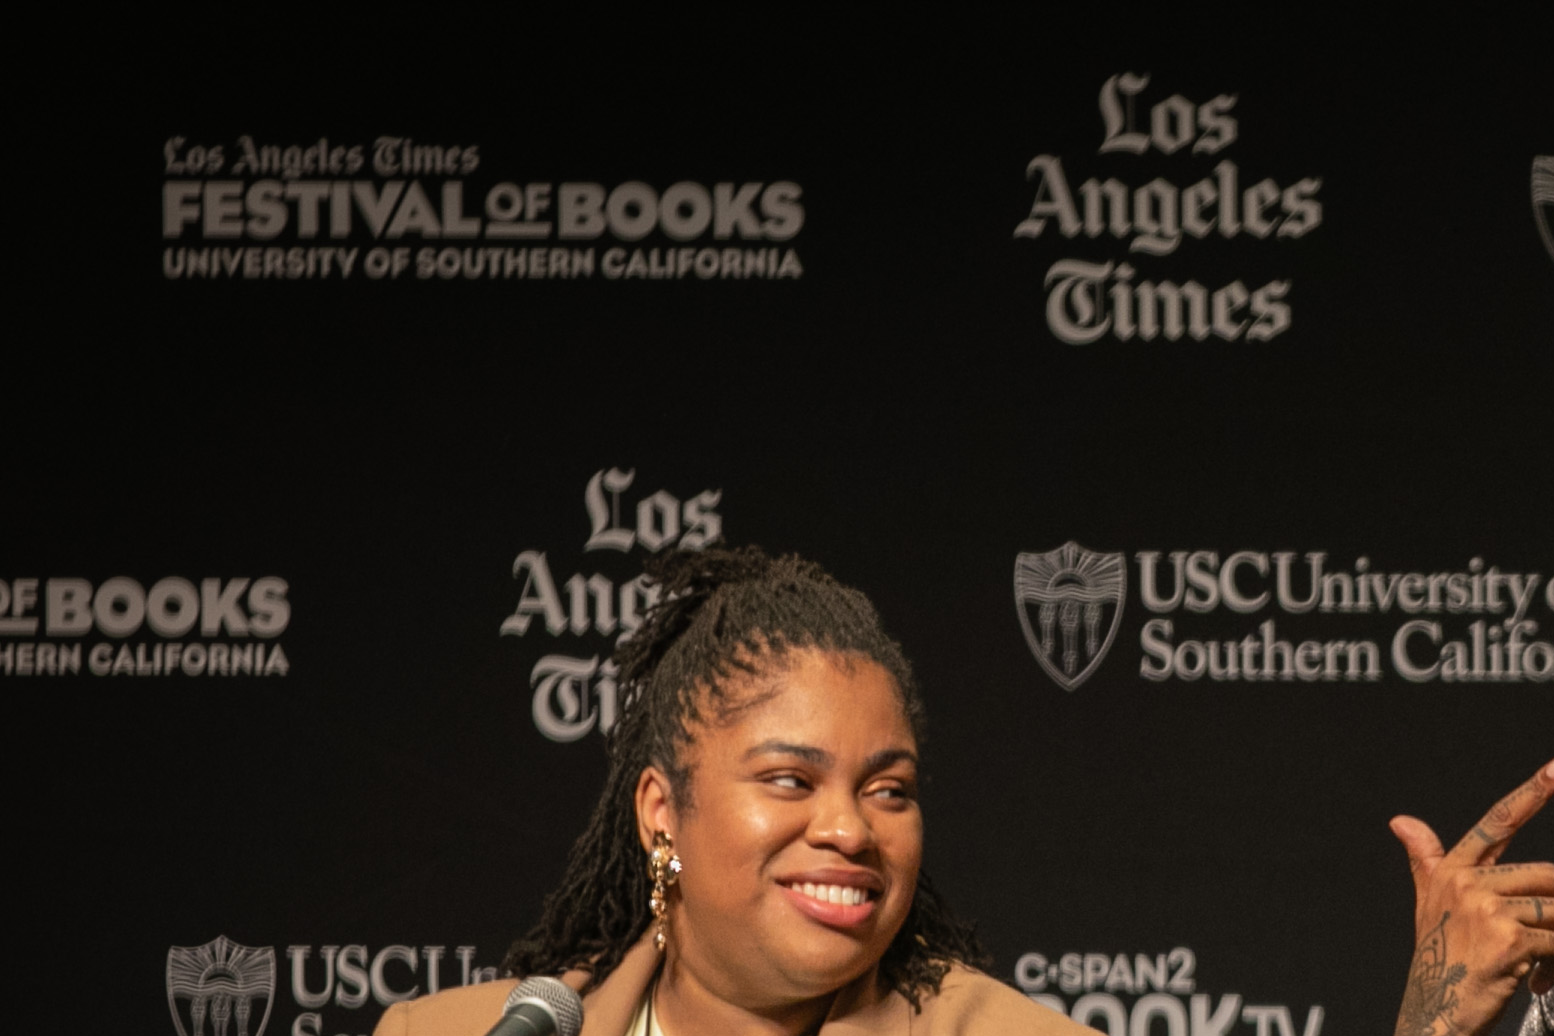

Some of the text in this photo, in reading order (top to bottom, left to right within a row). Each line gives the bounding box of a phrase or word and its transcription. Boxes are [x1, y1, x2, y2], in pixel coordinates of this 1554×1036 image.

[1097, 70, 1240, 156] Los
[163, 136, 480, 180] Los Angeles Times
[164, 181, 804, 240] FESTIVAL OF BOOKS
[1012, 155, 1325, 257] Angeles
[163, 248, 803, 281] UNIVERSITY OF SOUTHERN CALIFORNIA
[1043, 258, 1294, 347] Times
[583, 465, 724, 553] Los
[45, 575, 292, 640] BOOKS
[1136, 550, 1272, 614] USC
[1275, 550, 1539, 624] University
[88, 641, 291, 678] CALIFORNIA
[1138, 619, 1382, 683] Southern
[286, 943, 420, 1010] USC
